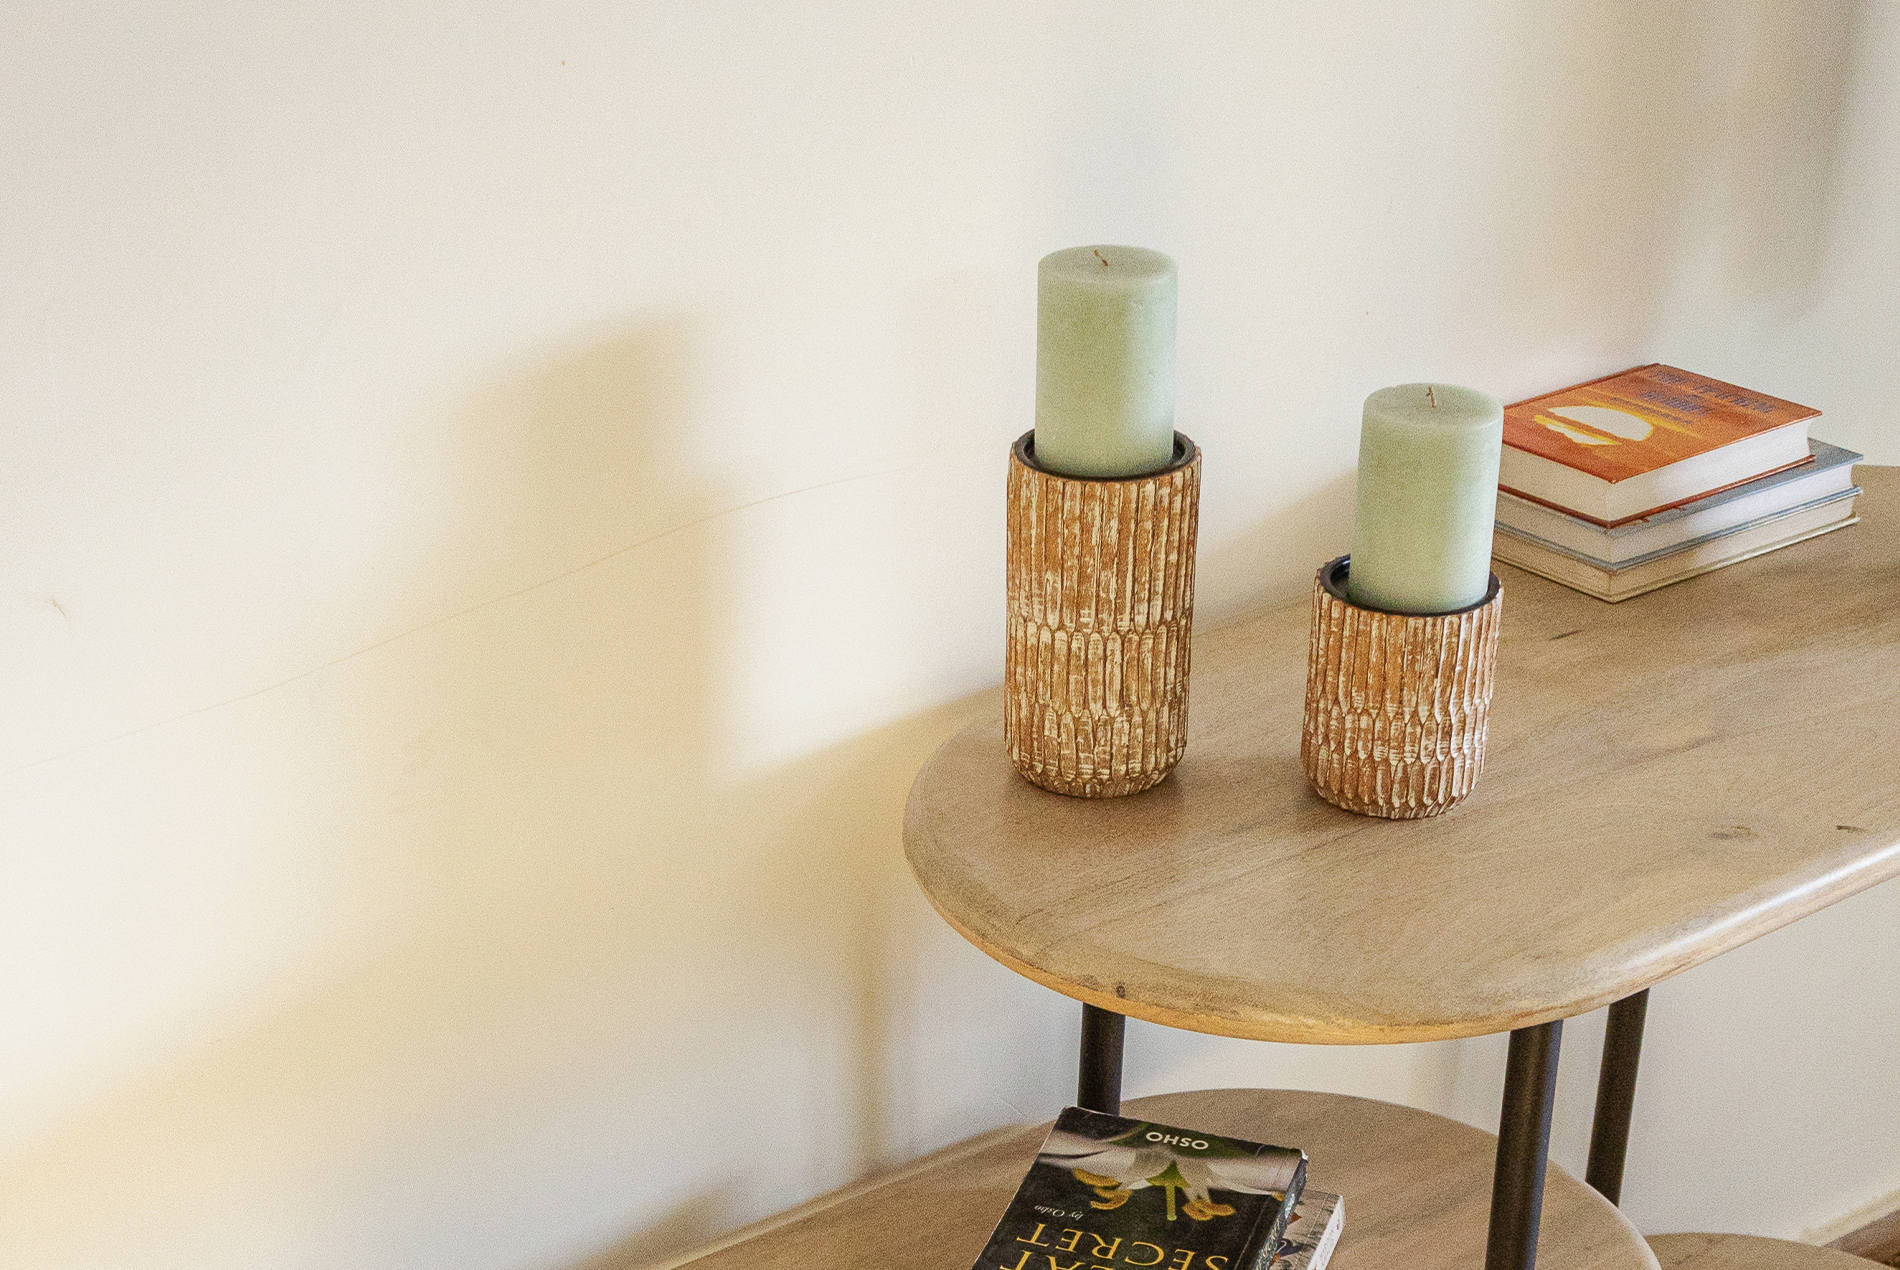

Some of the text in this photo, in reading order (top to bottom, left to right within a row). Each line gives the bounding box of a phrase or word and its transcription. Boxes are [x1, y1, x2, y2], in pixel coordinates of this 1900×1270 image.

[1145, 1131, 1209, 1150] OSHO
[1034, 1204, 1085, 1221] by Osho
